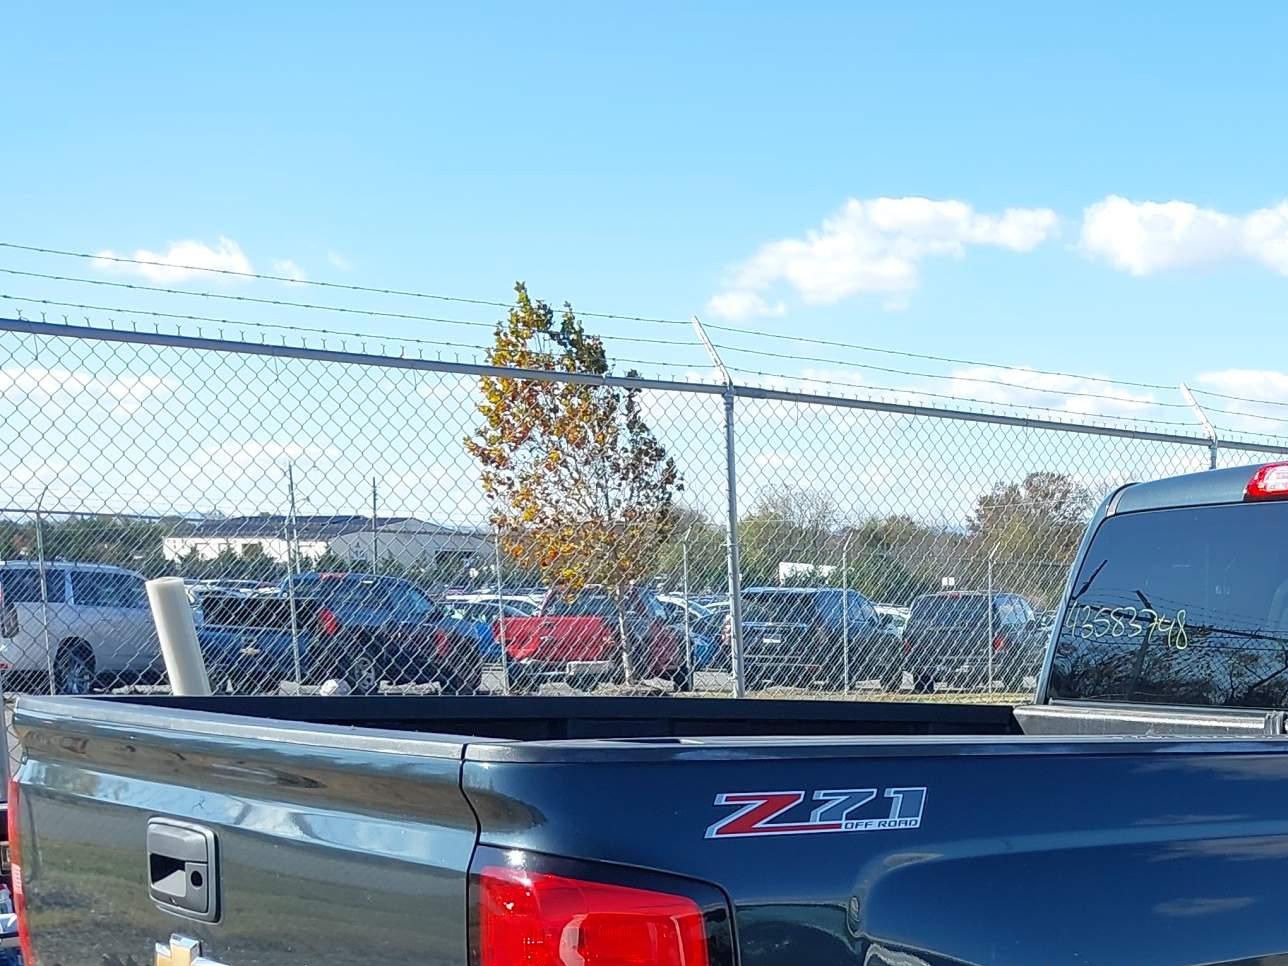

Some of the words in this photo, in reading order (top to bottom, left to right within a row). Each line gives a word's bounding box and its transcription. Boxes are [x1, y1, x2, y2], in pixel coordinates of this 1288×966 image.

[1067, 602, 1188, 649] 43583748
[704, 787, 928, 838] Z71
[844, 819, 874, 830] OFF
[878, 817, 918, 829] ROAD
